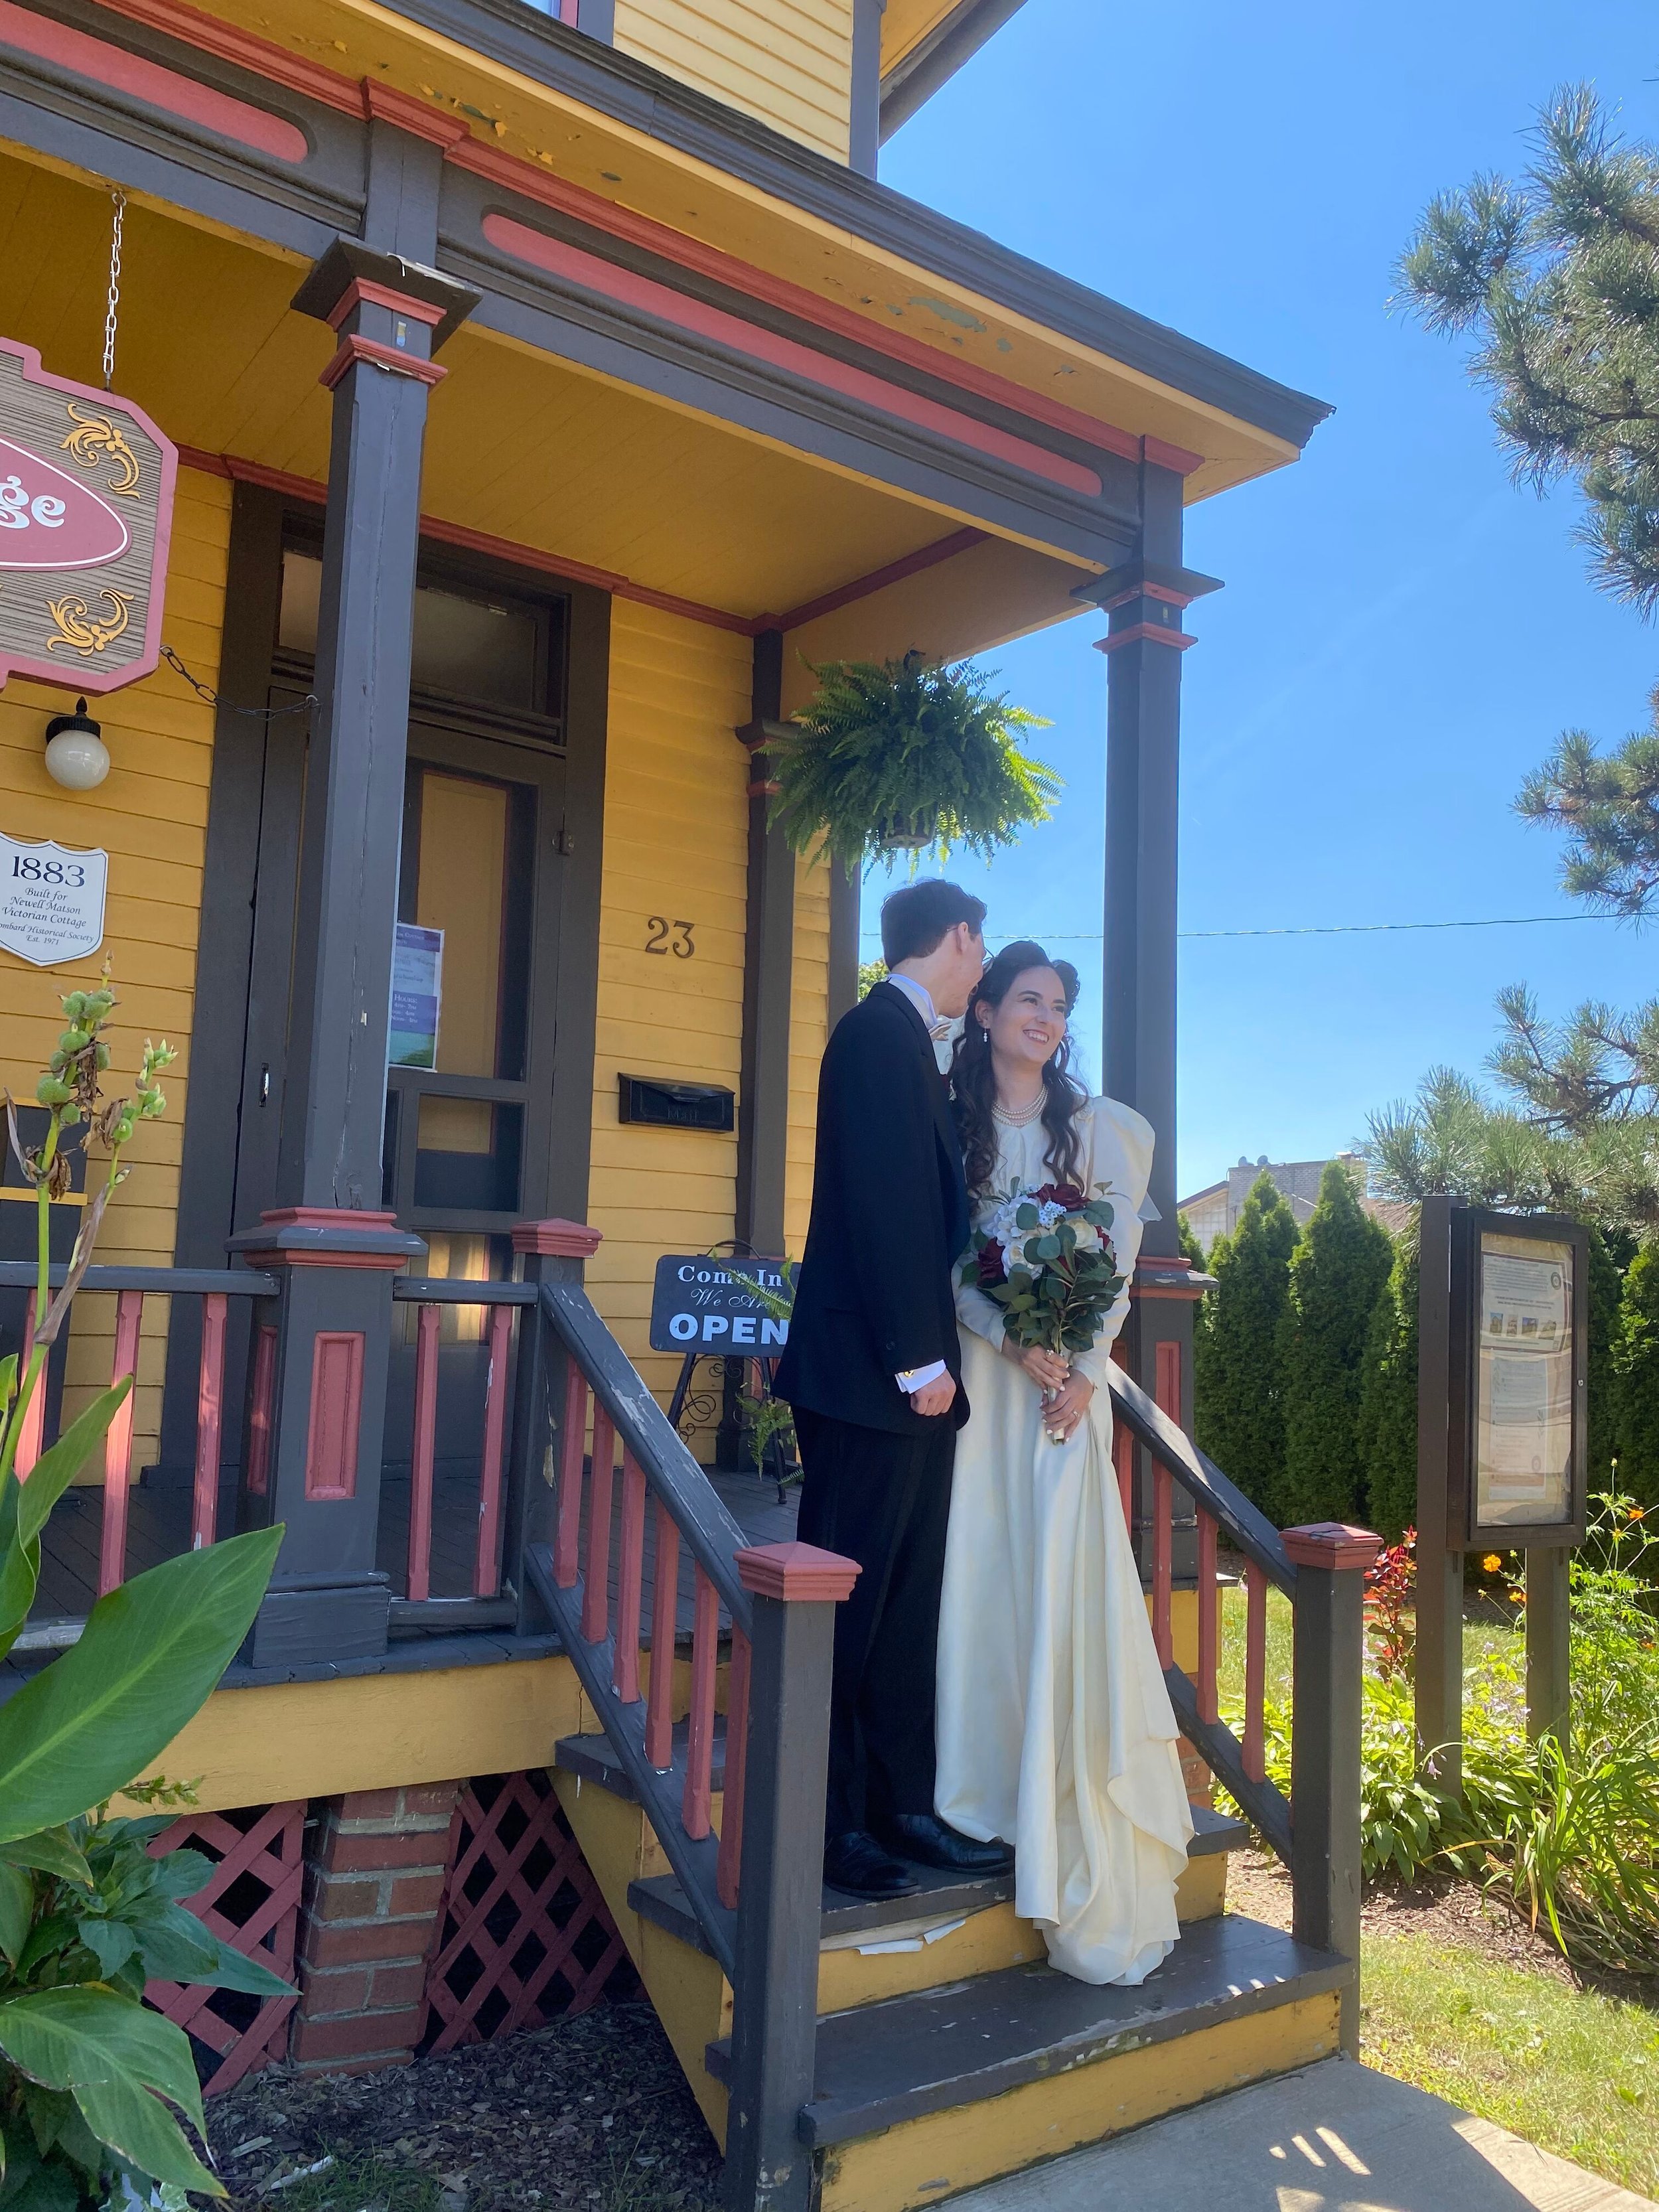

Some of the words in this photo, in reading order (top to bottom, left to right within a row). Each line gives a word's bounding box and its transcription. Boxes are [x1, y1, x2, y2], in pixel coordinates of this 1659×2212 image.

[11, 855, 85, 887] 1883
[25, 887, 50, 898] Built
[50, 891, 68, 902] for
[10, 897, 46, 909] Newell
[46, 902, 81, 915] Matson
[2, 907, 47, 921] Victorian
[50, 914, 86, 929] Cottage
[27, 926, 68, 937] Historical
[67, 931, 94, 943] Society
[645, 917, 695, 958] 23
[757, 1269, 782, 1287] In
[691, 1288, 723, 1307] We
[669, 1313, 789, 1345] OPEN
